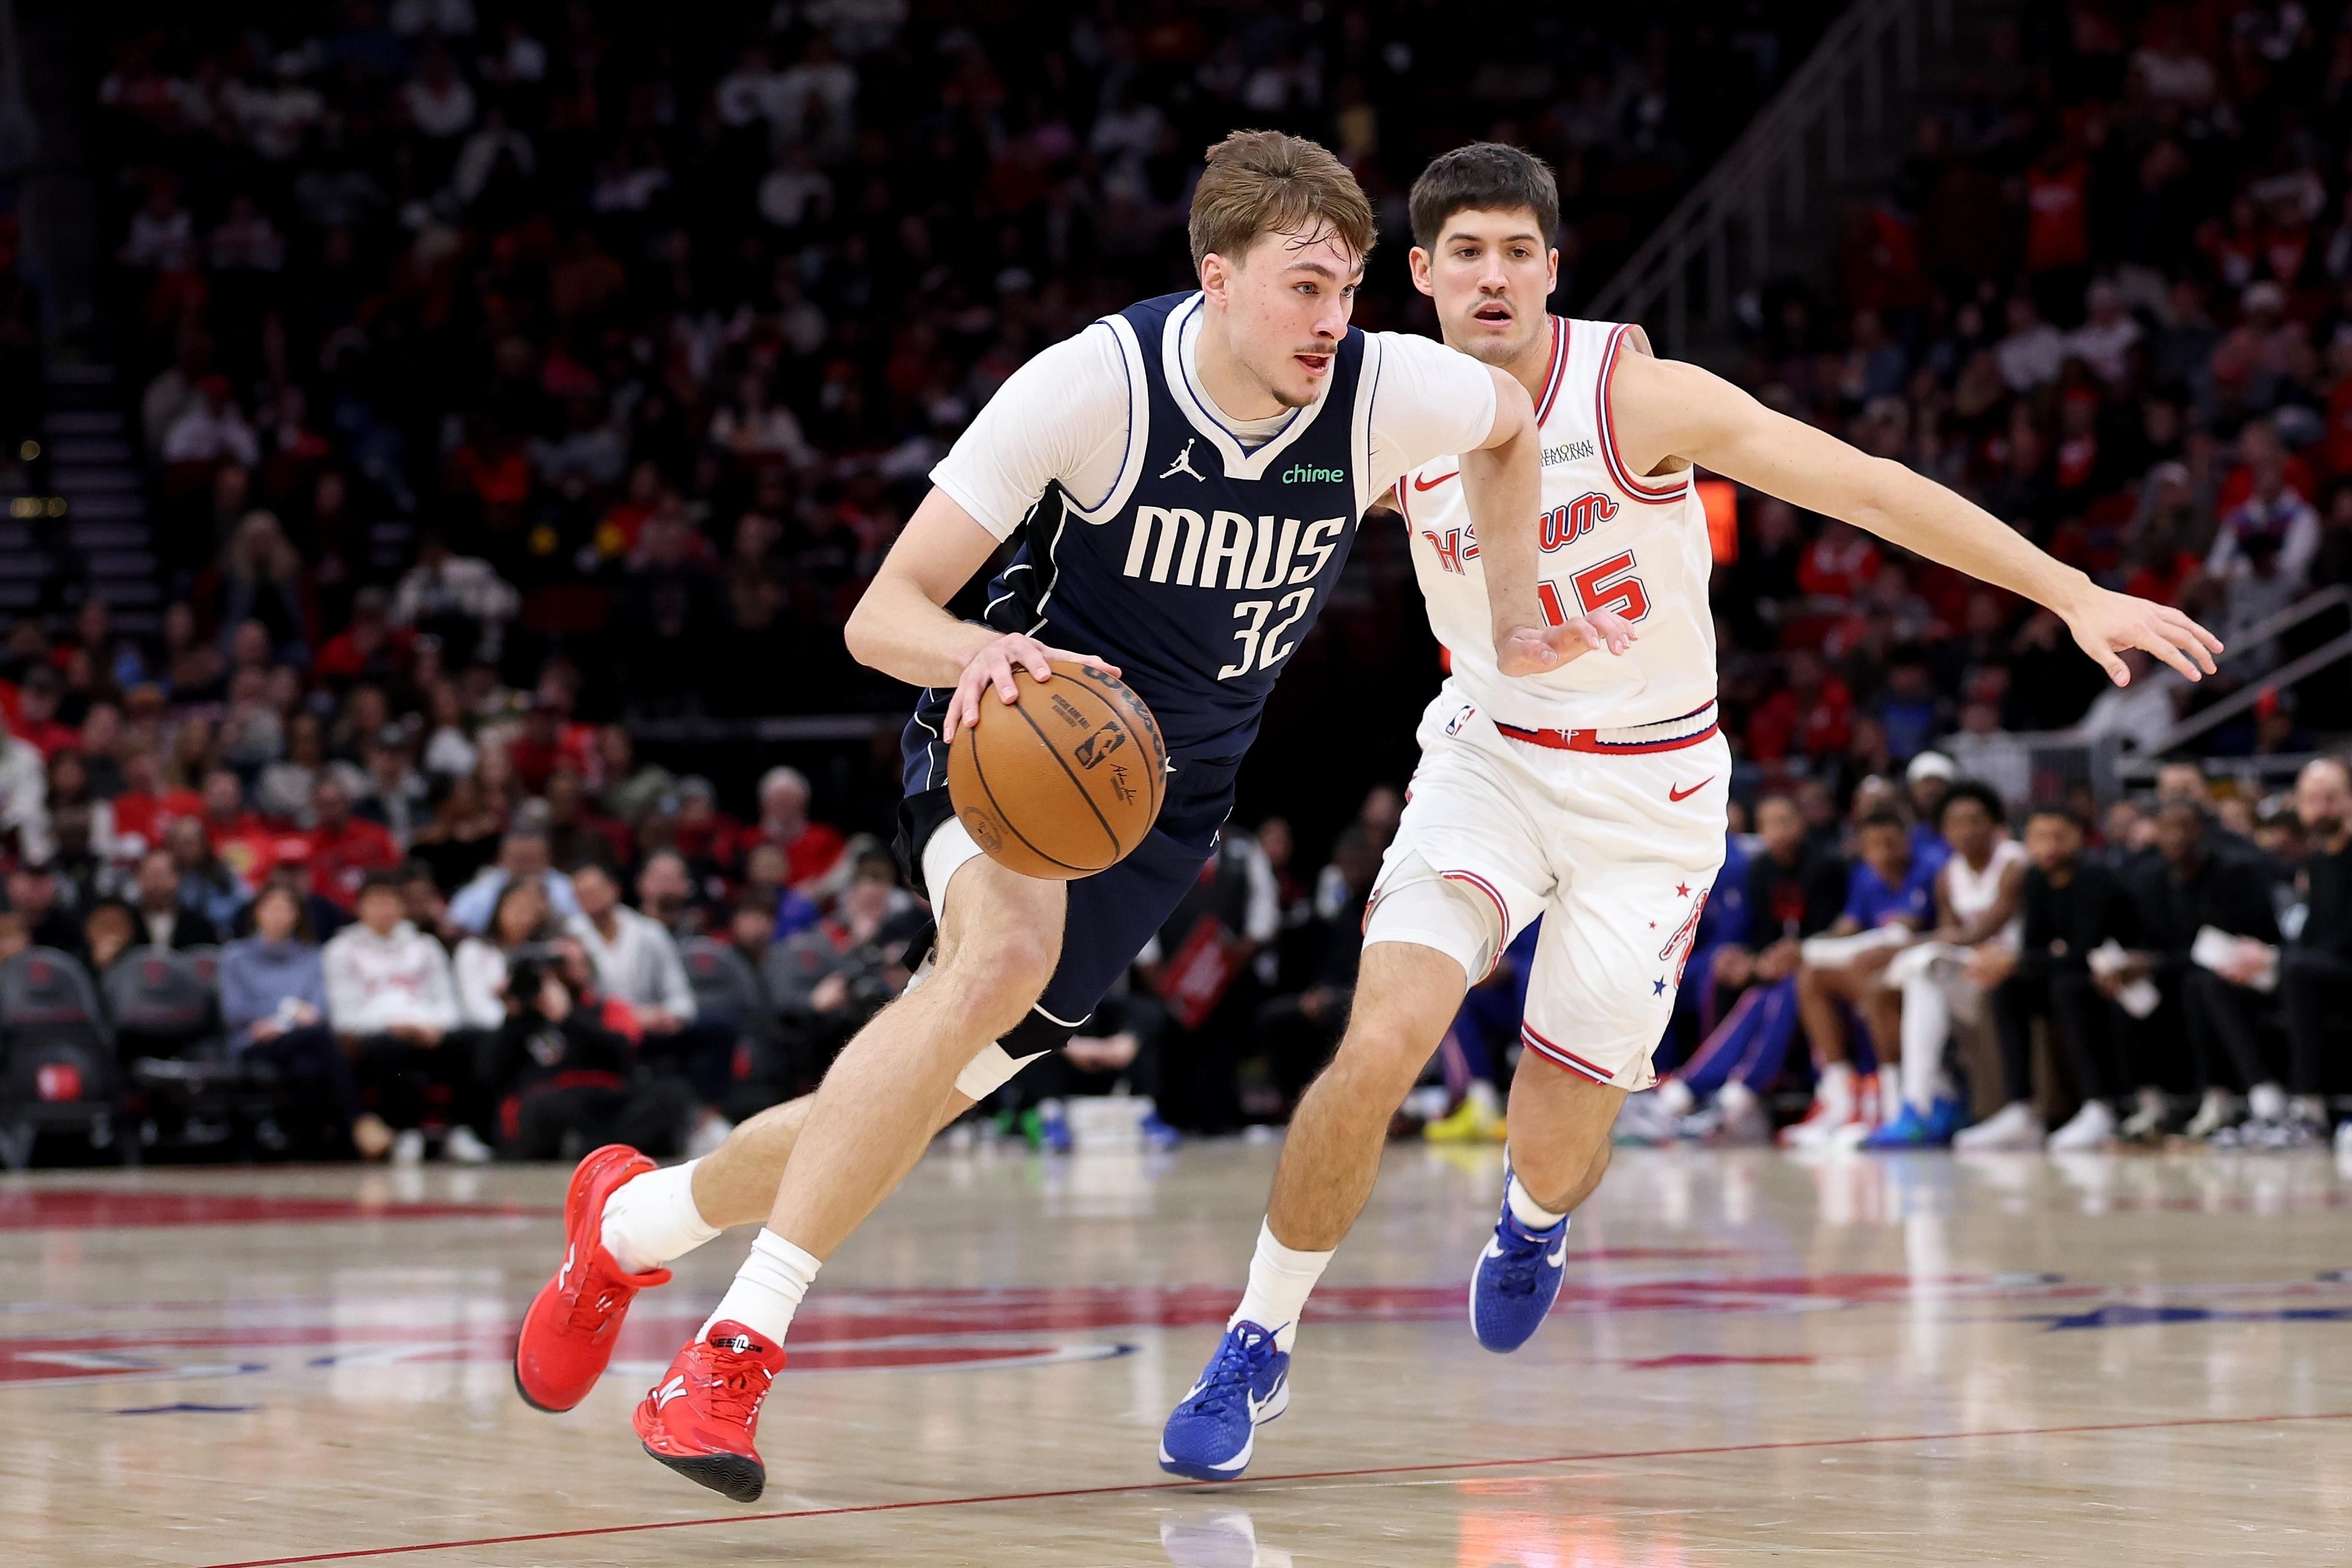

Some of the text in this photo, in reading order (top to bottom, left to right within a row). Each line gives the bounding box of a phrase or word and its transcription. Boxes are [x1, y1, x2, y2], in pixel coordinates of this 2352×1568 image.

[1282, 464, 1344, 484] chime
[1123, 505, 1346, 590] MAVS
[1538, 549, 1651, 627] 15
[1217, 587, 1314, 680] 32
